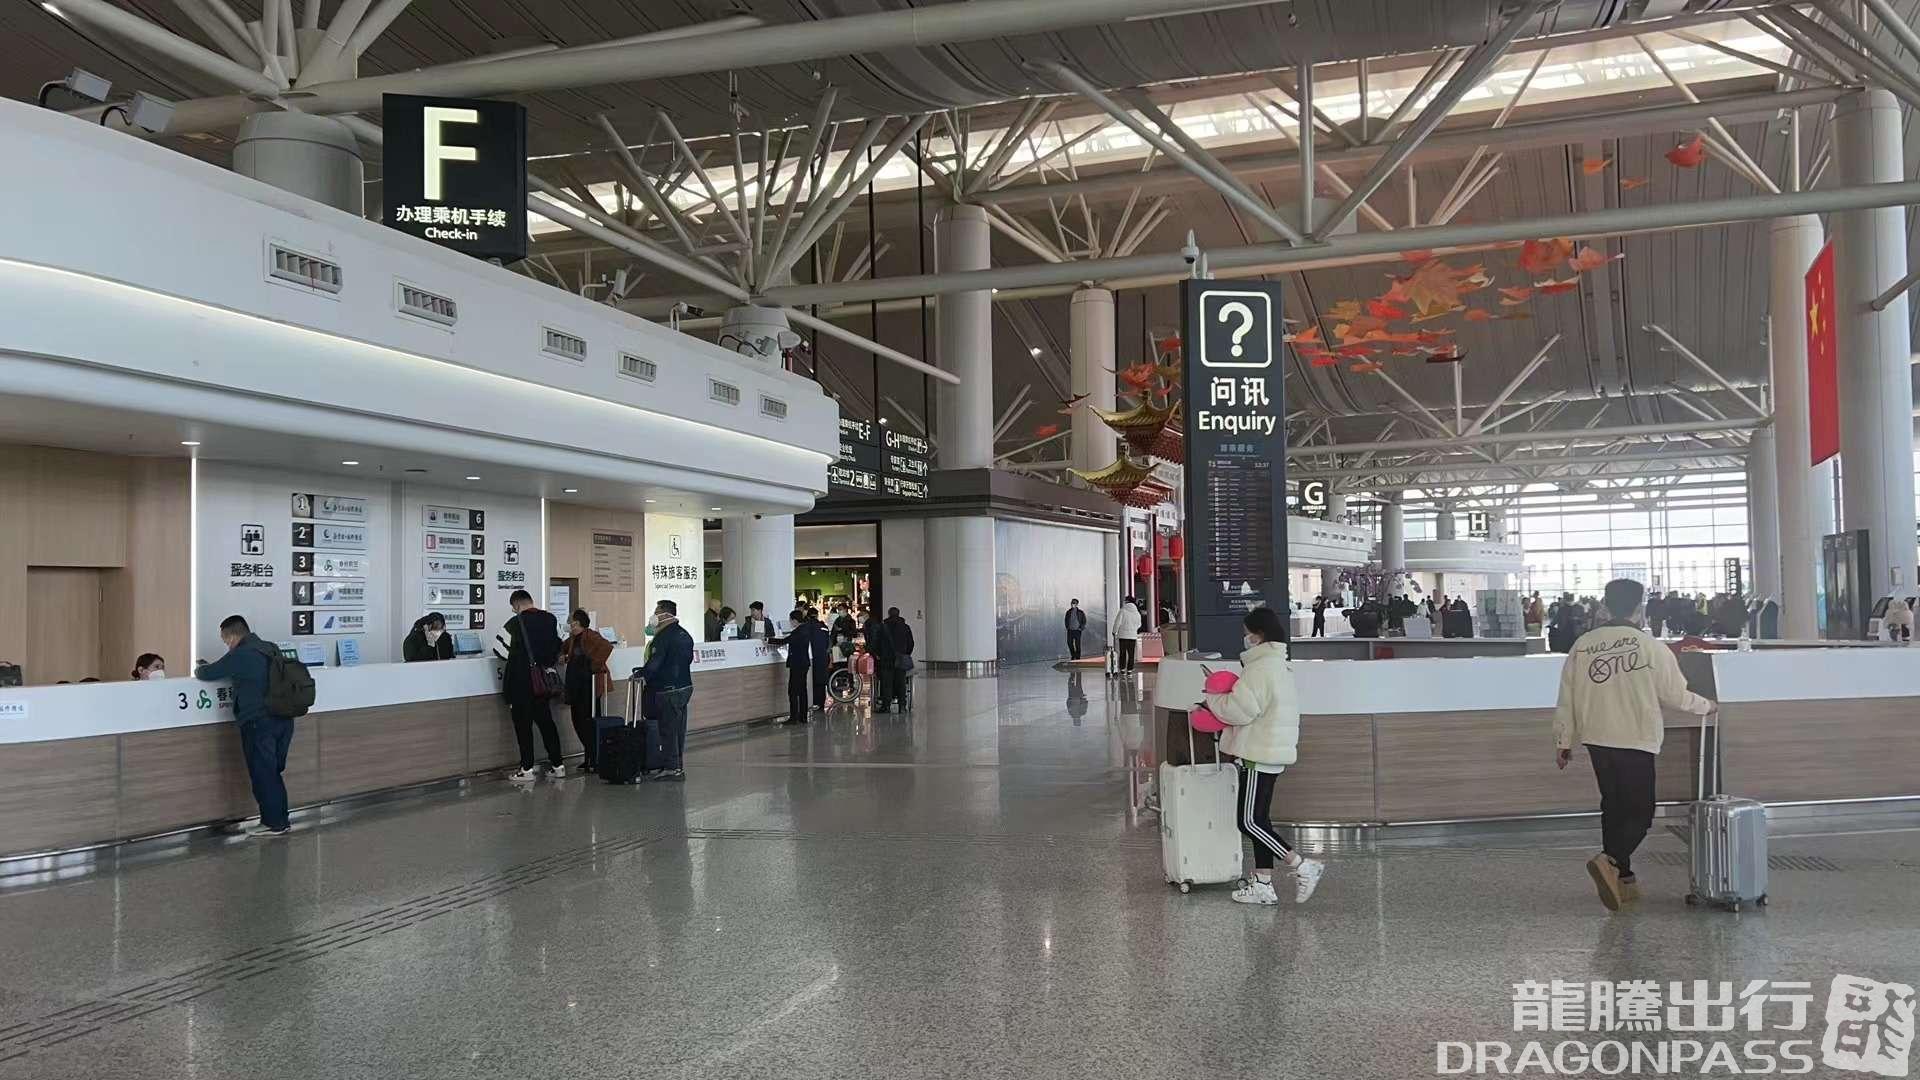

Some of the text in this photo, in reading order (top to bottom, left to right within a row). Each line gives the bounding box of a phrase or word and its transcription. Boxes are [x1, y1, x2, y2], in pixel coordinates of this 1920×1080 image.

[424, 106, 478, 200] F
[396, 204, 506, 227] 办理乘机手续
[424, 227, 478, 241] Check-in
[1210, 376, 1269, 407] 问讯
[1198, 410, 1276, 435] Enquiry
[886, 431, 900, 448] G-H
[850, 470, 855, 487] 2
[1305, 482, 1324, 505] G
[299, 498, 305, 511] 1
[476, 513, 482, 524] 6
[1471, 514, 1486, 530] H
[299, 526, 306, 539] 2
[476, 537, 482, 548] 7
[299, 555, 306, 568] 3
[476, 562, 482, 573] 8
[231, 563, 273, 577] 服务柜台
[498, 570, 525, 581] 服务柜台
[652, 565, 697, 580] 特殊旅客服务
[298, 585, 306, 598] 4
[476, 587, 482, 598] 9
[298, 614, 306, 627] 5
[474, 612, 484, 623] 10
[178, 692, 188, 710] 3
